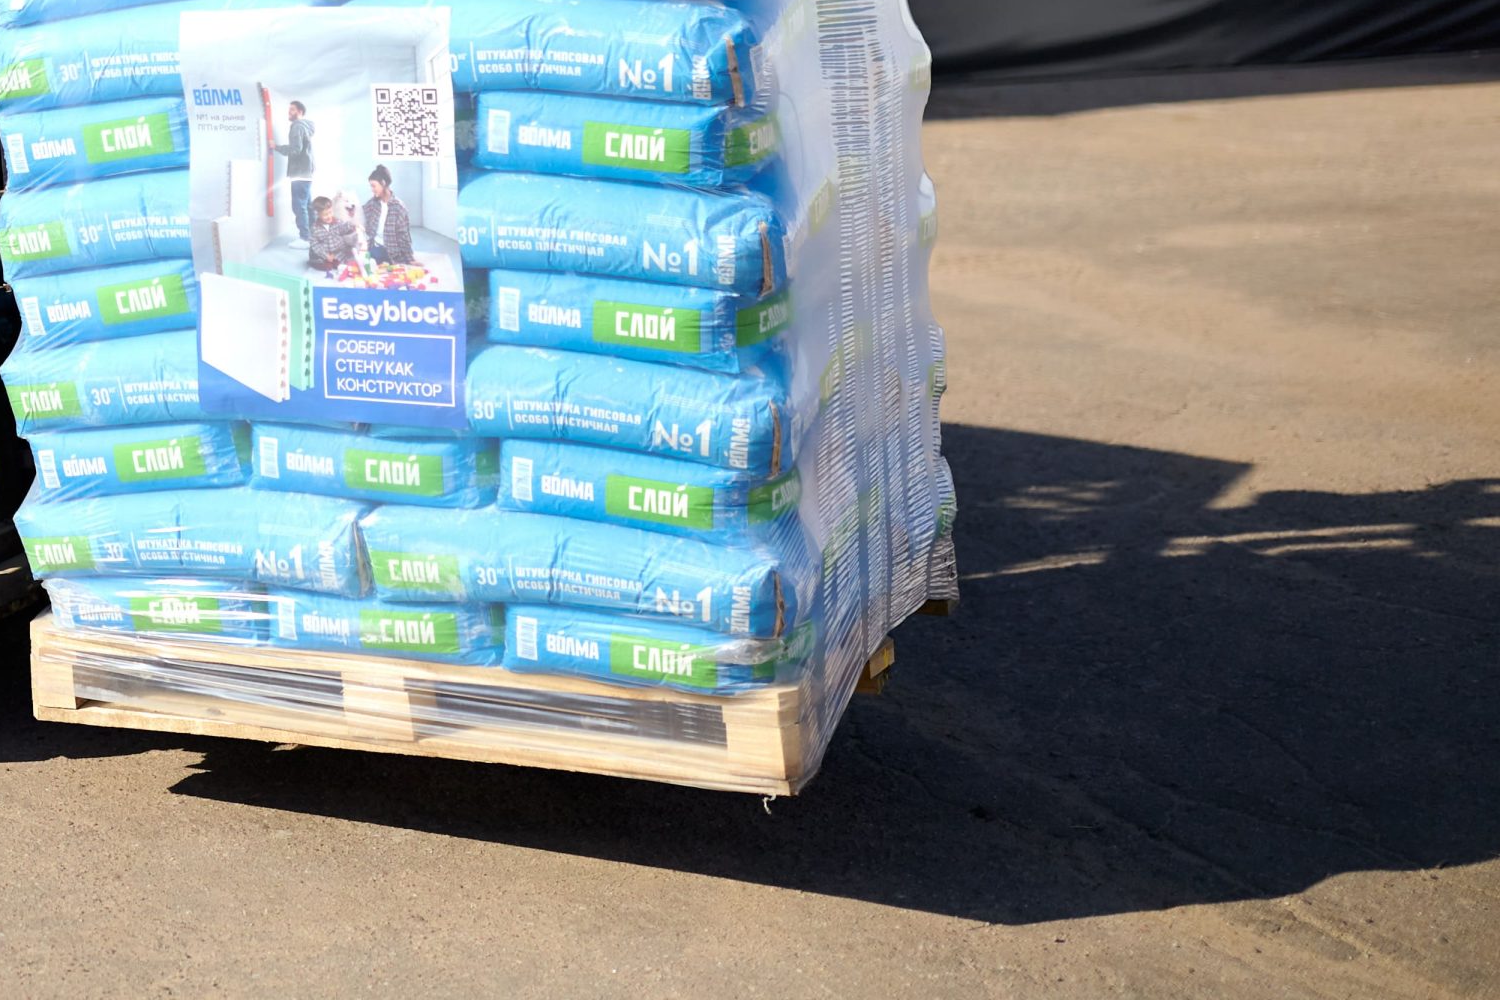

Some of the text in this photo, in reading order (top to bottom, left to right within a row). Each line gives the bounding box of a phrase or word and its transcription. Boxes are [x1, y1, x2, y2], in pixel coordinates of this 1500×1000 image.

[478, 63, 512, 73] ОСОБО
[101, 116, 152, 152] СЛОЙ
[604, 128, 666, 162] СЛОЙ
[9, 224, 52, 255] СЛОЙ
[498, 239, 532, 250] ОСОБО
[115, 279, 167, 314] СЛОЙ
[322, 298, 455, 326] Easyblock
[615, 308, 676, 341] СЛОЙ
[336, 339, 395, 356] СОБЕРИ
[335, 358, 414, 377] СТЕНУ КАК
[20, 383, 63, 413] СЛОЙ
[336, 378, 443, 399] КОНСТРУКТОР
[514, 413, 549, 424] ОСОБО
[583, 406, 642, 426] ГИПСОВАЯ
[131, 439, 184, 474] СЛОЙ
[364, 455, 420, 487] СЛОЙ
[628, 485, 688, 518] СЛОЙ
[33, 537, 77, 567] СЛОЙ
[388, 555, 440, 584] СЛОЙ
[517, 580, 550, 591] ОСОБО
[379, 613, 436, 644] СЛОЙ
